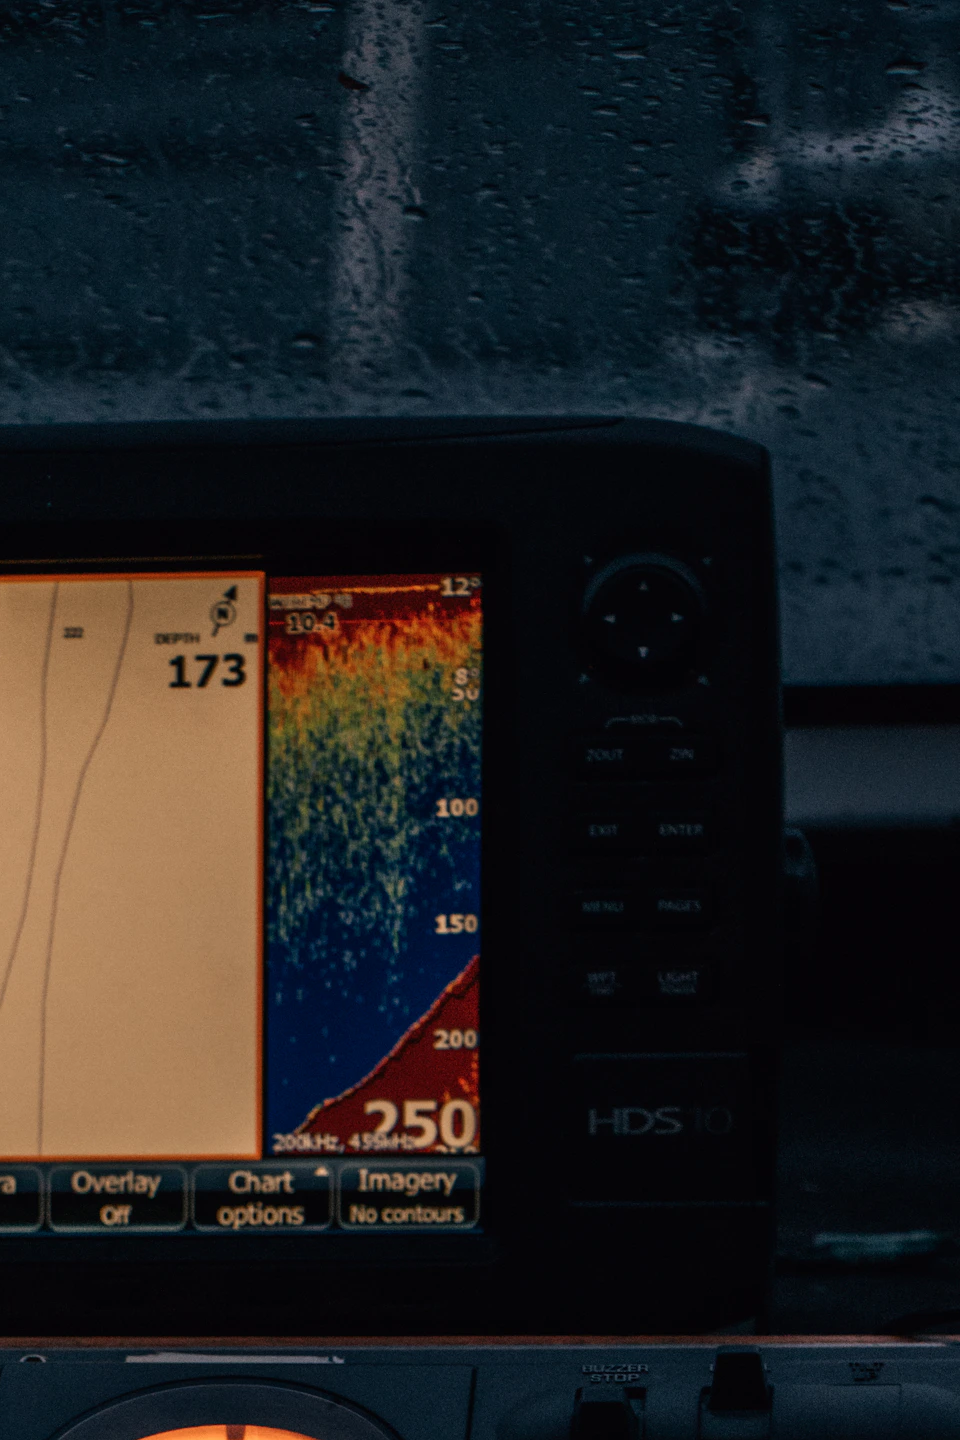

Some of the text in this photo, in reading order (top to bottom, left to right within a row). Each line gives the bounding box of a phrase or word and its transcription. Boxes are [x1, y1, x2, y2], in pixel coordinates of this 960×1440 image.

[290, 614, 335, 631] 10.4
[155, 632, 200, 645] DEPTH
[169, 653, 246, 688] 173
[436, 799, 479, 817] 100
[658, 823, 704, 837] ENTER
[581, 900, 624, 913] MENU
[657, 899, 702, 913] PAGES
[434, 914, 479, 935] 150
[433, 1029, 478, 1050] 200
[363, 1099, 477, 1149] 250
[587, 1105, 684, 1136] HDS
[70, 1170, 162, 1199] Overlay
[228, 1170, 295, 1194] Chart
[357, 1168, 457, 1197] Imagery
[99, 1203, 133, 1226] Off
[216, 1201, 306, 1230] options
[349, 1203, 465, 1224] No contours
[582, 1364, 649, 1373] BUZZER
[590, 1373, 640, 1383] STOP
